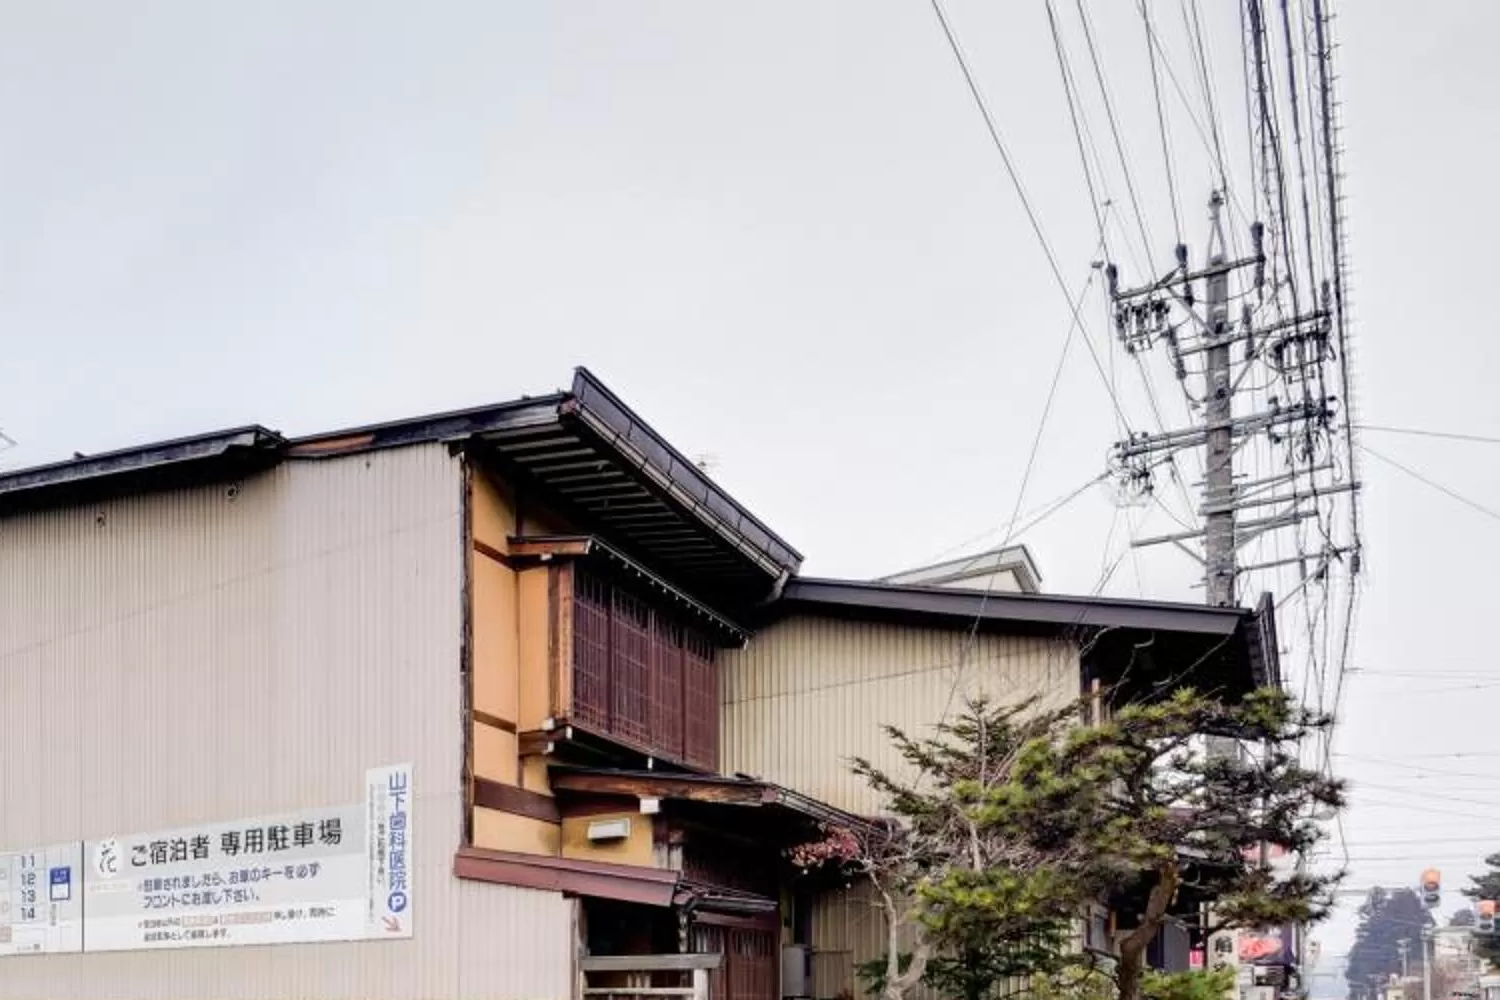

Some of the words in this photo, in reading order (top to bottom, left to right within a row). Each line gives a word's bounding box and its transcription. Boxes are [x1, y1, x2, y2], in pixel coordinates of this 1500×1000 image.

[131, 834, 211, 867] ご宿泊者
[220, 817, 342, 857] 専用駐車場
[21, 854, 36, 868] 11
[21, 871, 36, 886] 12
[21, 889, 36, 903] 13
[21, 907, 36, 920] 14
